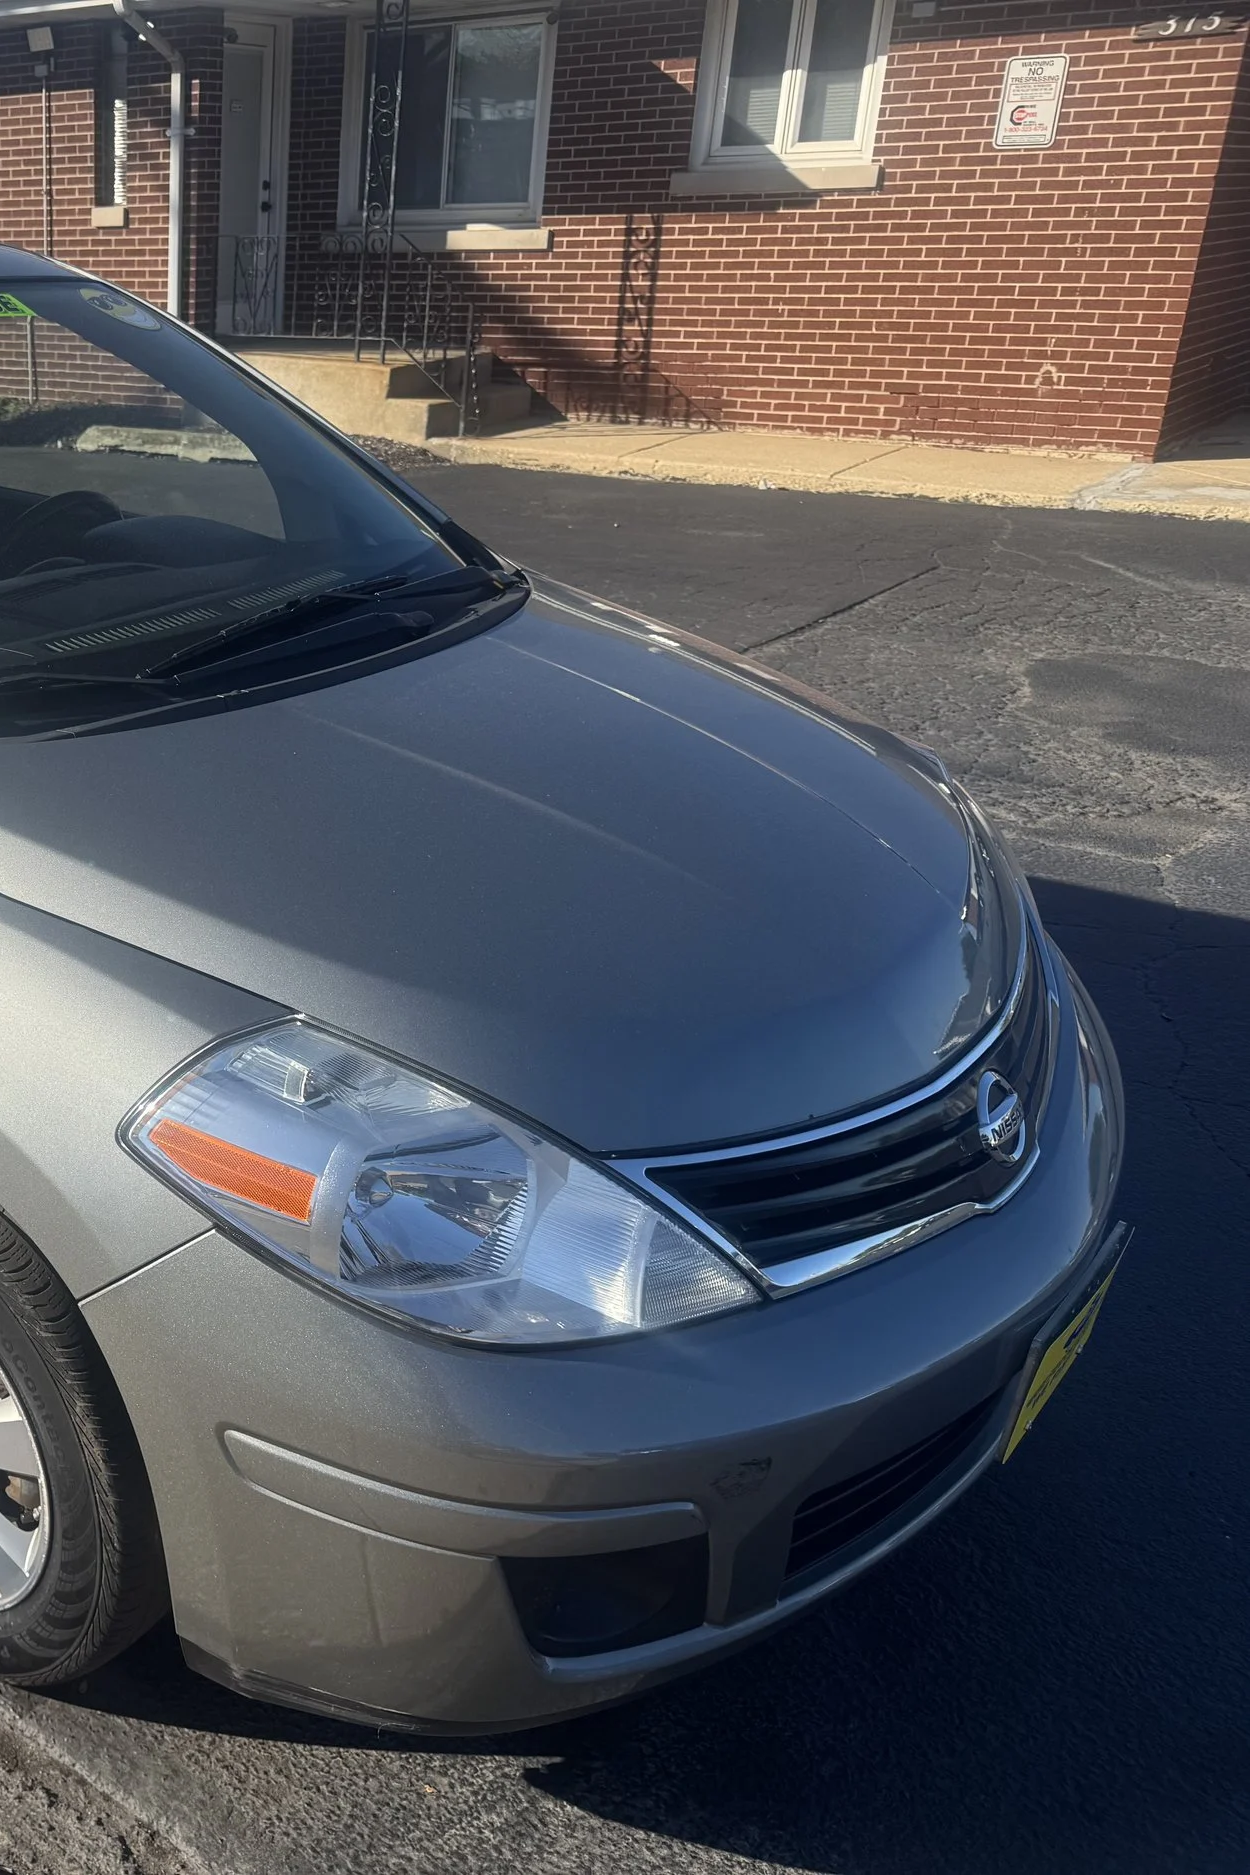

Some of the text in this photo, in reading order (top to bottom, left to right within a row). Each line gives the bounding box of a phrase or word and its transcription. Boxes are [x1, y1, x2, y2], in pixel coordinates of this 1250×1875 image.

[1158, 11, 1225, 35] 315
[1027, 67, 1044, 76] NO
[1010, 75, 1060, 83] TRESPASSING
